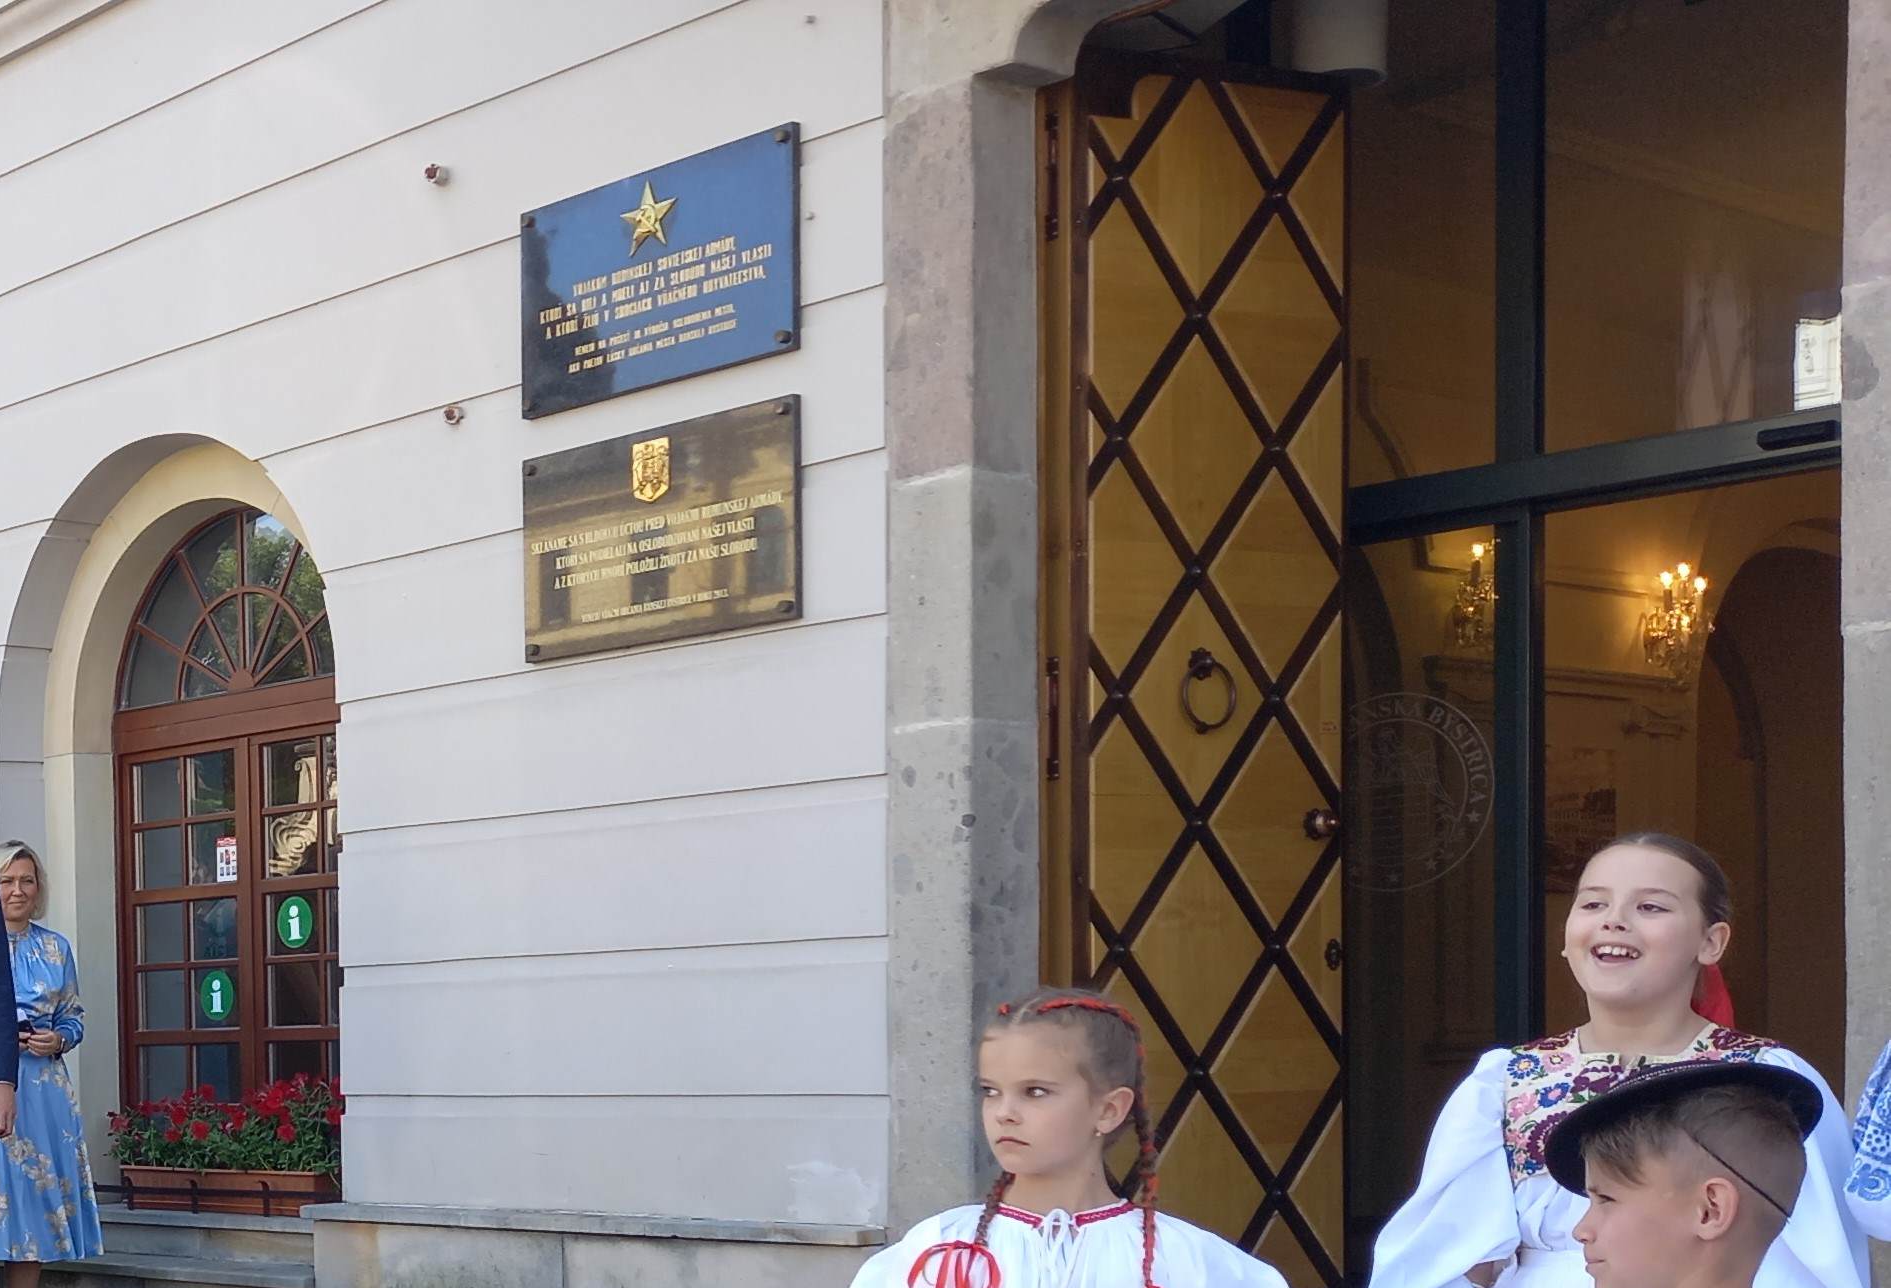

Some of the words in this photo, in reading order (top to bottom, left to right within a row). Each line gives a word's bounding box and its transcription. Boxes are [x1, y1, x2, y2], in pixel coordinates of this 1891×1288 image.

[742, 244, 771, 265] VLASTI
[645, 516, 664, 531] PRED
[726, 517, 754, 534] VLASTI
[1427, 707, 1488, 804] BYSTRICA
